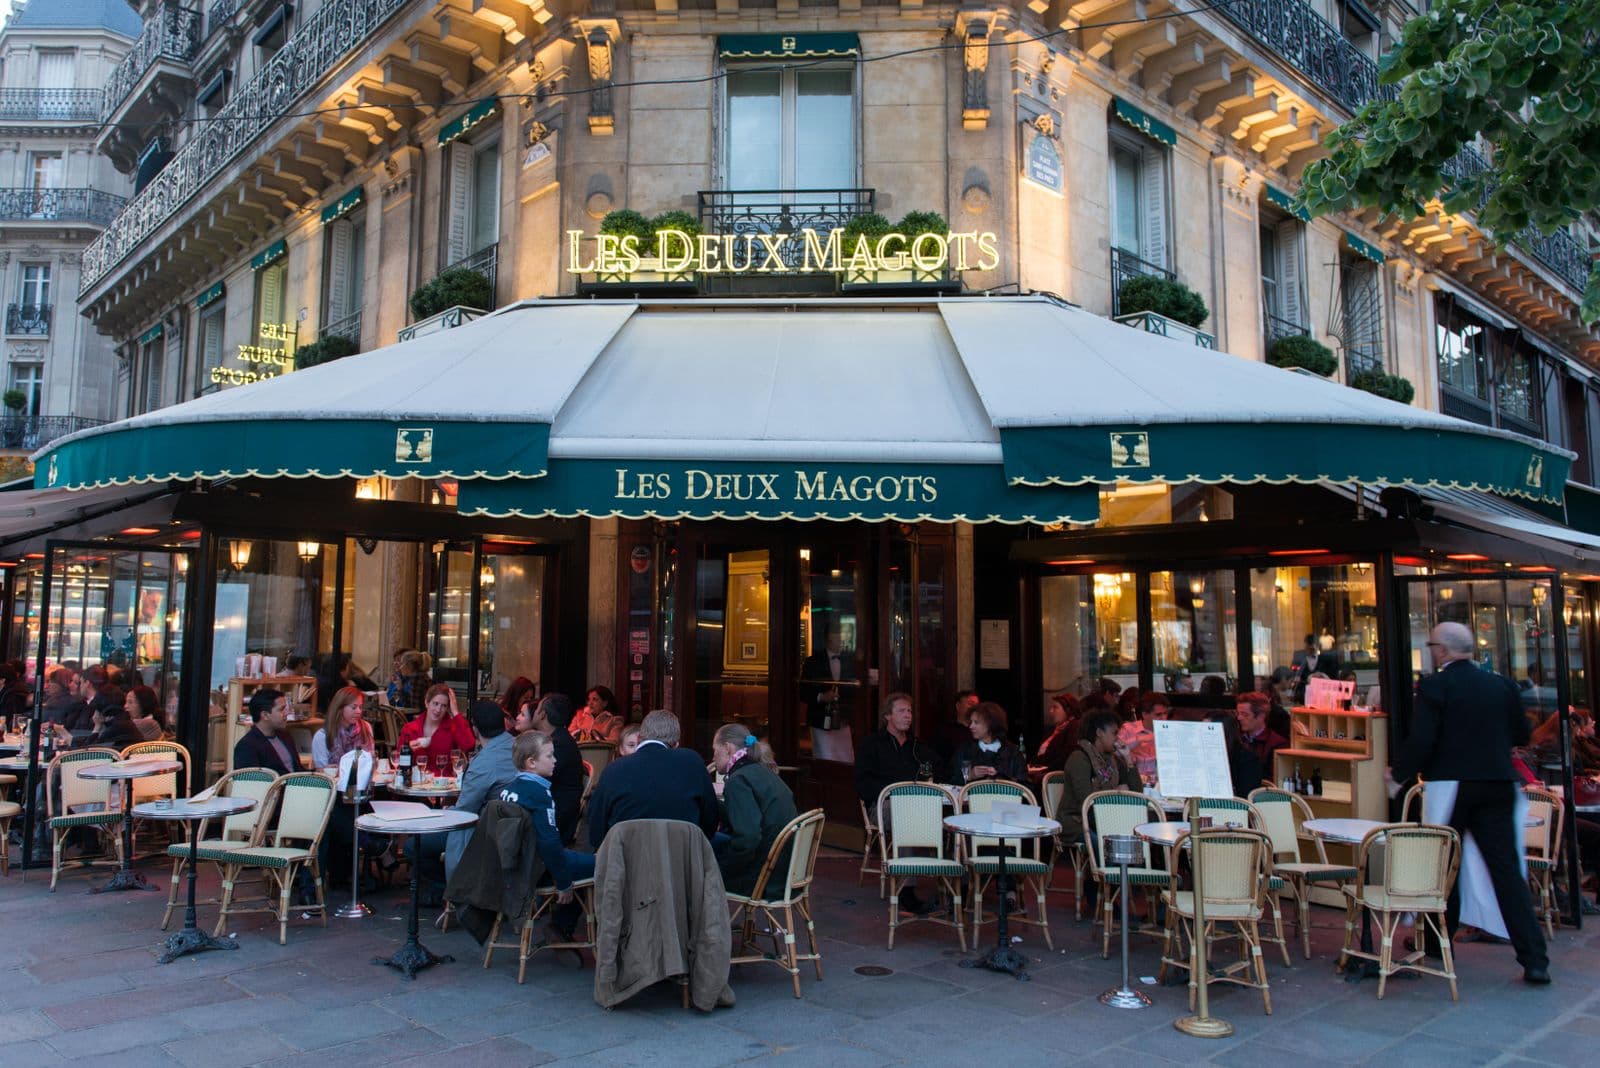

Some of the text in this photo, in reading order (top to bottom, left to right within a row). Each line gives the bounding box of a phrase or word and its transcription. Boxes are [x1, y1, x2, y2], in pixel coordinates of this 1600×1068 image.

[566, 227, 1001, 274] LES DEUX MAGOTS
[614, 469, 938, 502] LES DEUX MAGOTS
